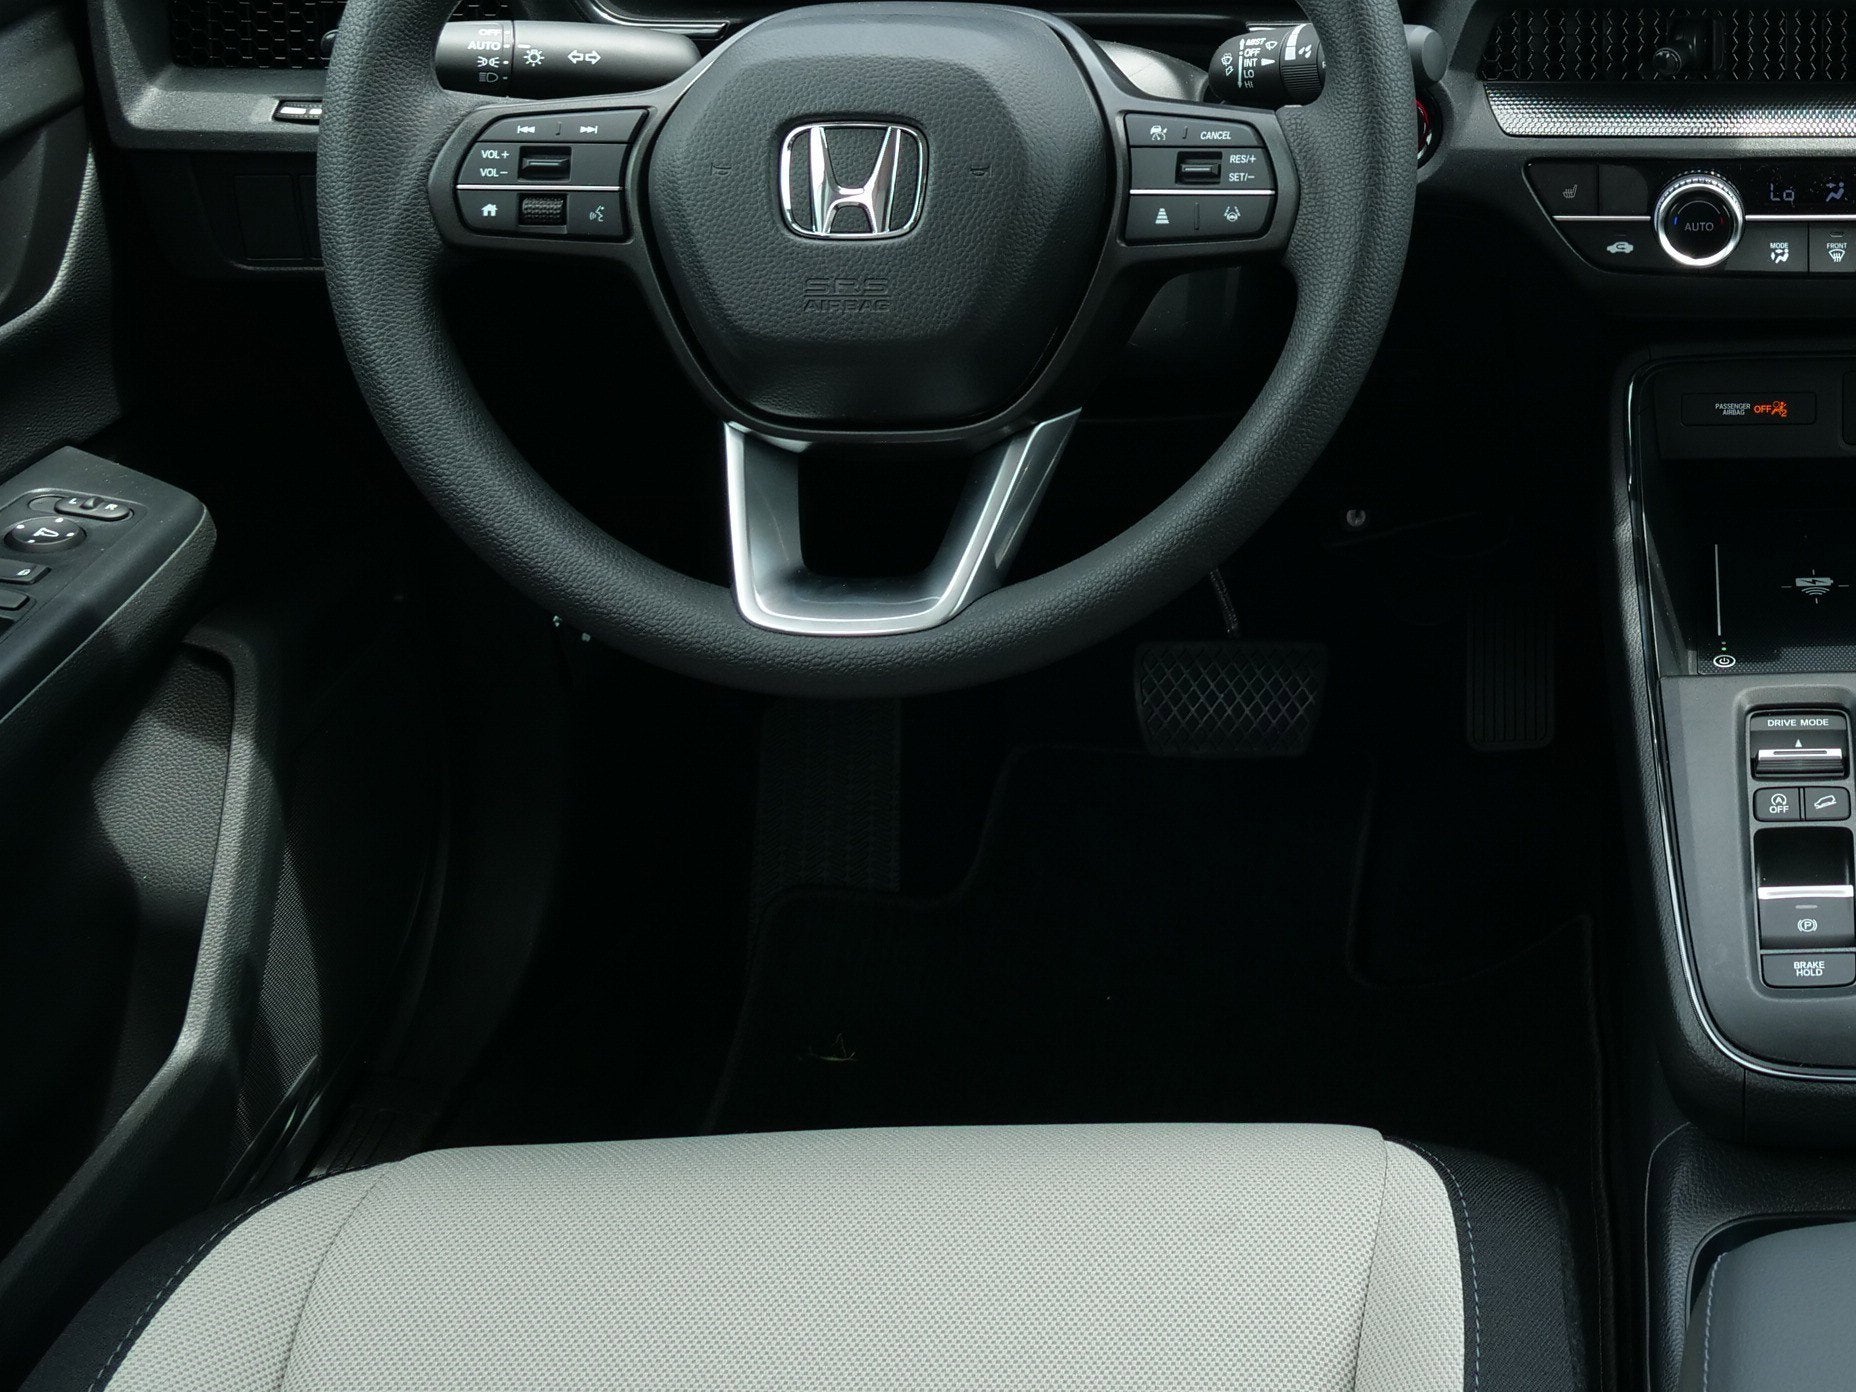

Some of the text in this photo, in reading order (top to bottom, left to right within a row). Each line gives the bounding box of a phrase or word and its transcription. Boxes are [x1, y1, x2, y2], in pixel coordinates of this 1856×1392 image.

[478, 28, 502, 37] OFF
[468, 41, 501, 50] AUTO
[1244, 48, 1261, 57] OFF
[1244, 58, 1258, 67] INT
[1243, 70, 1254, 78] LO
[1200, 131, 1232, 140] CANCEL
[1683, 220, 1715, 233] AUTO
[803, 277, 890, 296] SRS
[1754, 404, 1772, 413] OFF
[1767, 718, 1829, 727] DRIVE MODE
[1769, 805, 1789, 814] OFF
[1794, 961, 1825, 969] BRAKE
